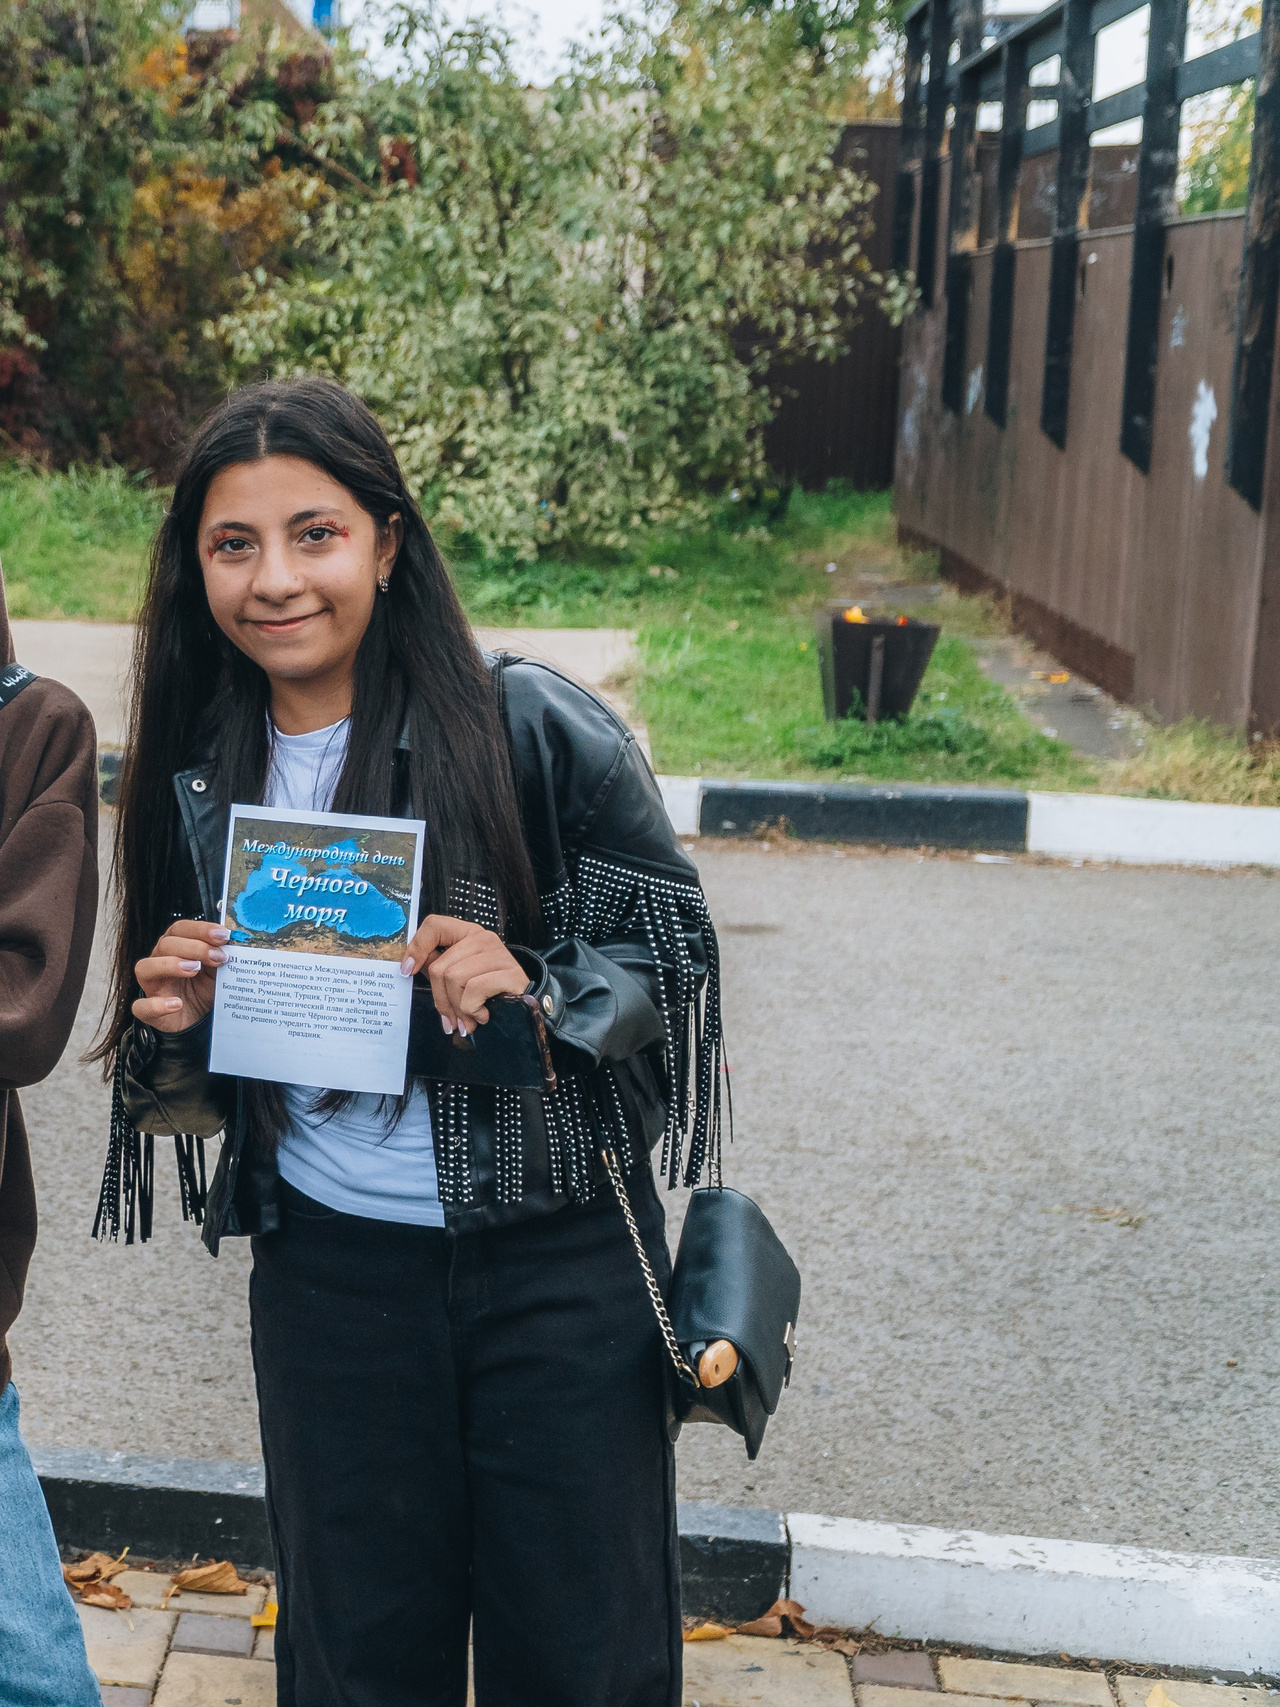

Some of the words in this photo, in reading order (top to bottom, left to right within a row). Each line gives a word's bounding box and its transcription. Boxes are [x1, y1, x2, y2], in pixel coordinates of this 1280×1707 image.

[242, 839, 369, 863] Международный
[372, 851, 406, 866] день
[270, 867, 368, 897] Черного
[284, 903, 347, 927] моря
[227, 965, 256, 975] Чёрного
[258, 970, 277, 978] моря.
[279, 972, 308, 980] Именно
[360, 979, 377, 987] 1996
[240, 958, 271, 967] октября
[273, 962, 312, 971] отмечается
[315, 965, 375, 978] Международный
[222, 983, 256, 994] Болгария,
[258, 988, 292, 998] Румыния,
[294, 992, 322, 1001] Турция,
[324, 995, 348, 1004] Грузия
[357, 998, 387, 1007] Украина
[259, 979, 323, 992] причерноморских
[357, 989, 384, 997] Россия,
[224, 1003, 272, 1014] реабилитации
[281, 1010, 306, 1018] защите
[308, 1012, 338, 1021] Чёрного
[340, 1016, 359, 1024] моря.
[361, 1017, 381, 1026] Тогда
[229, 995, 265, 1004] подписали
[267, 999, 324, 1011] Стратегический
[345, 1007, 378, 1016] действий
[232, 1012, 249, 1020] было
[251, 1016, 277, 1025] решено
[279, 1019, 311, 1028] учредить
[330, 1024, 383, 1035] экологический
[288, 1030, 323, 1039] праздник.
